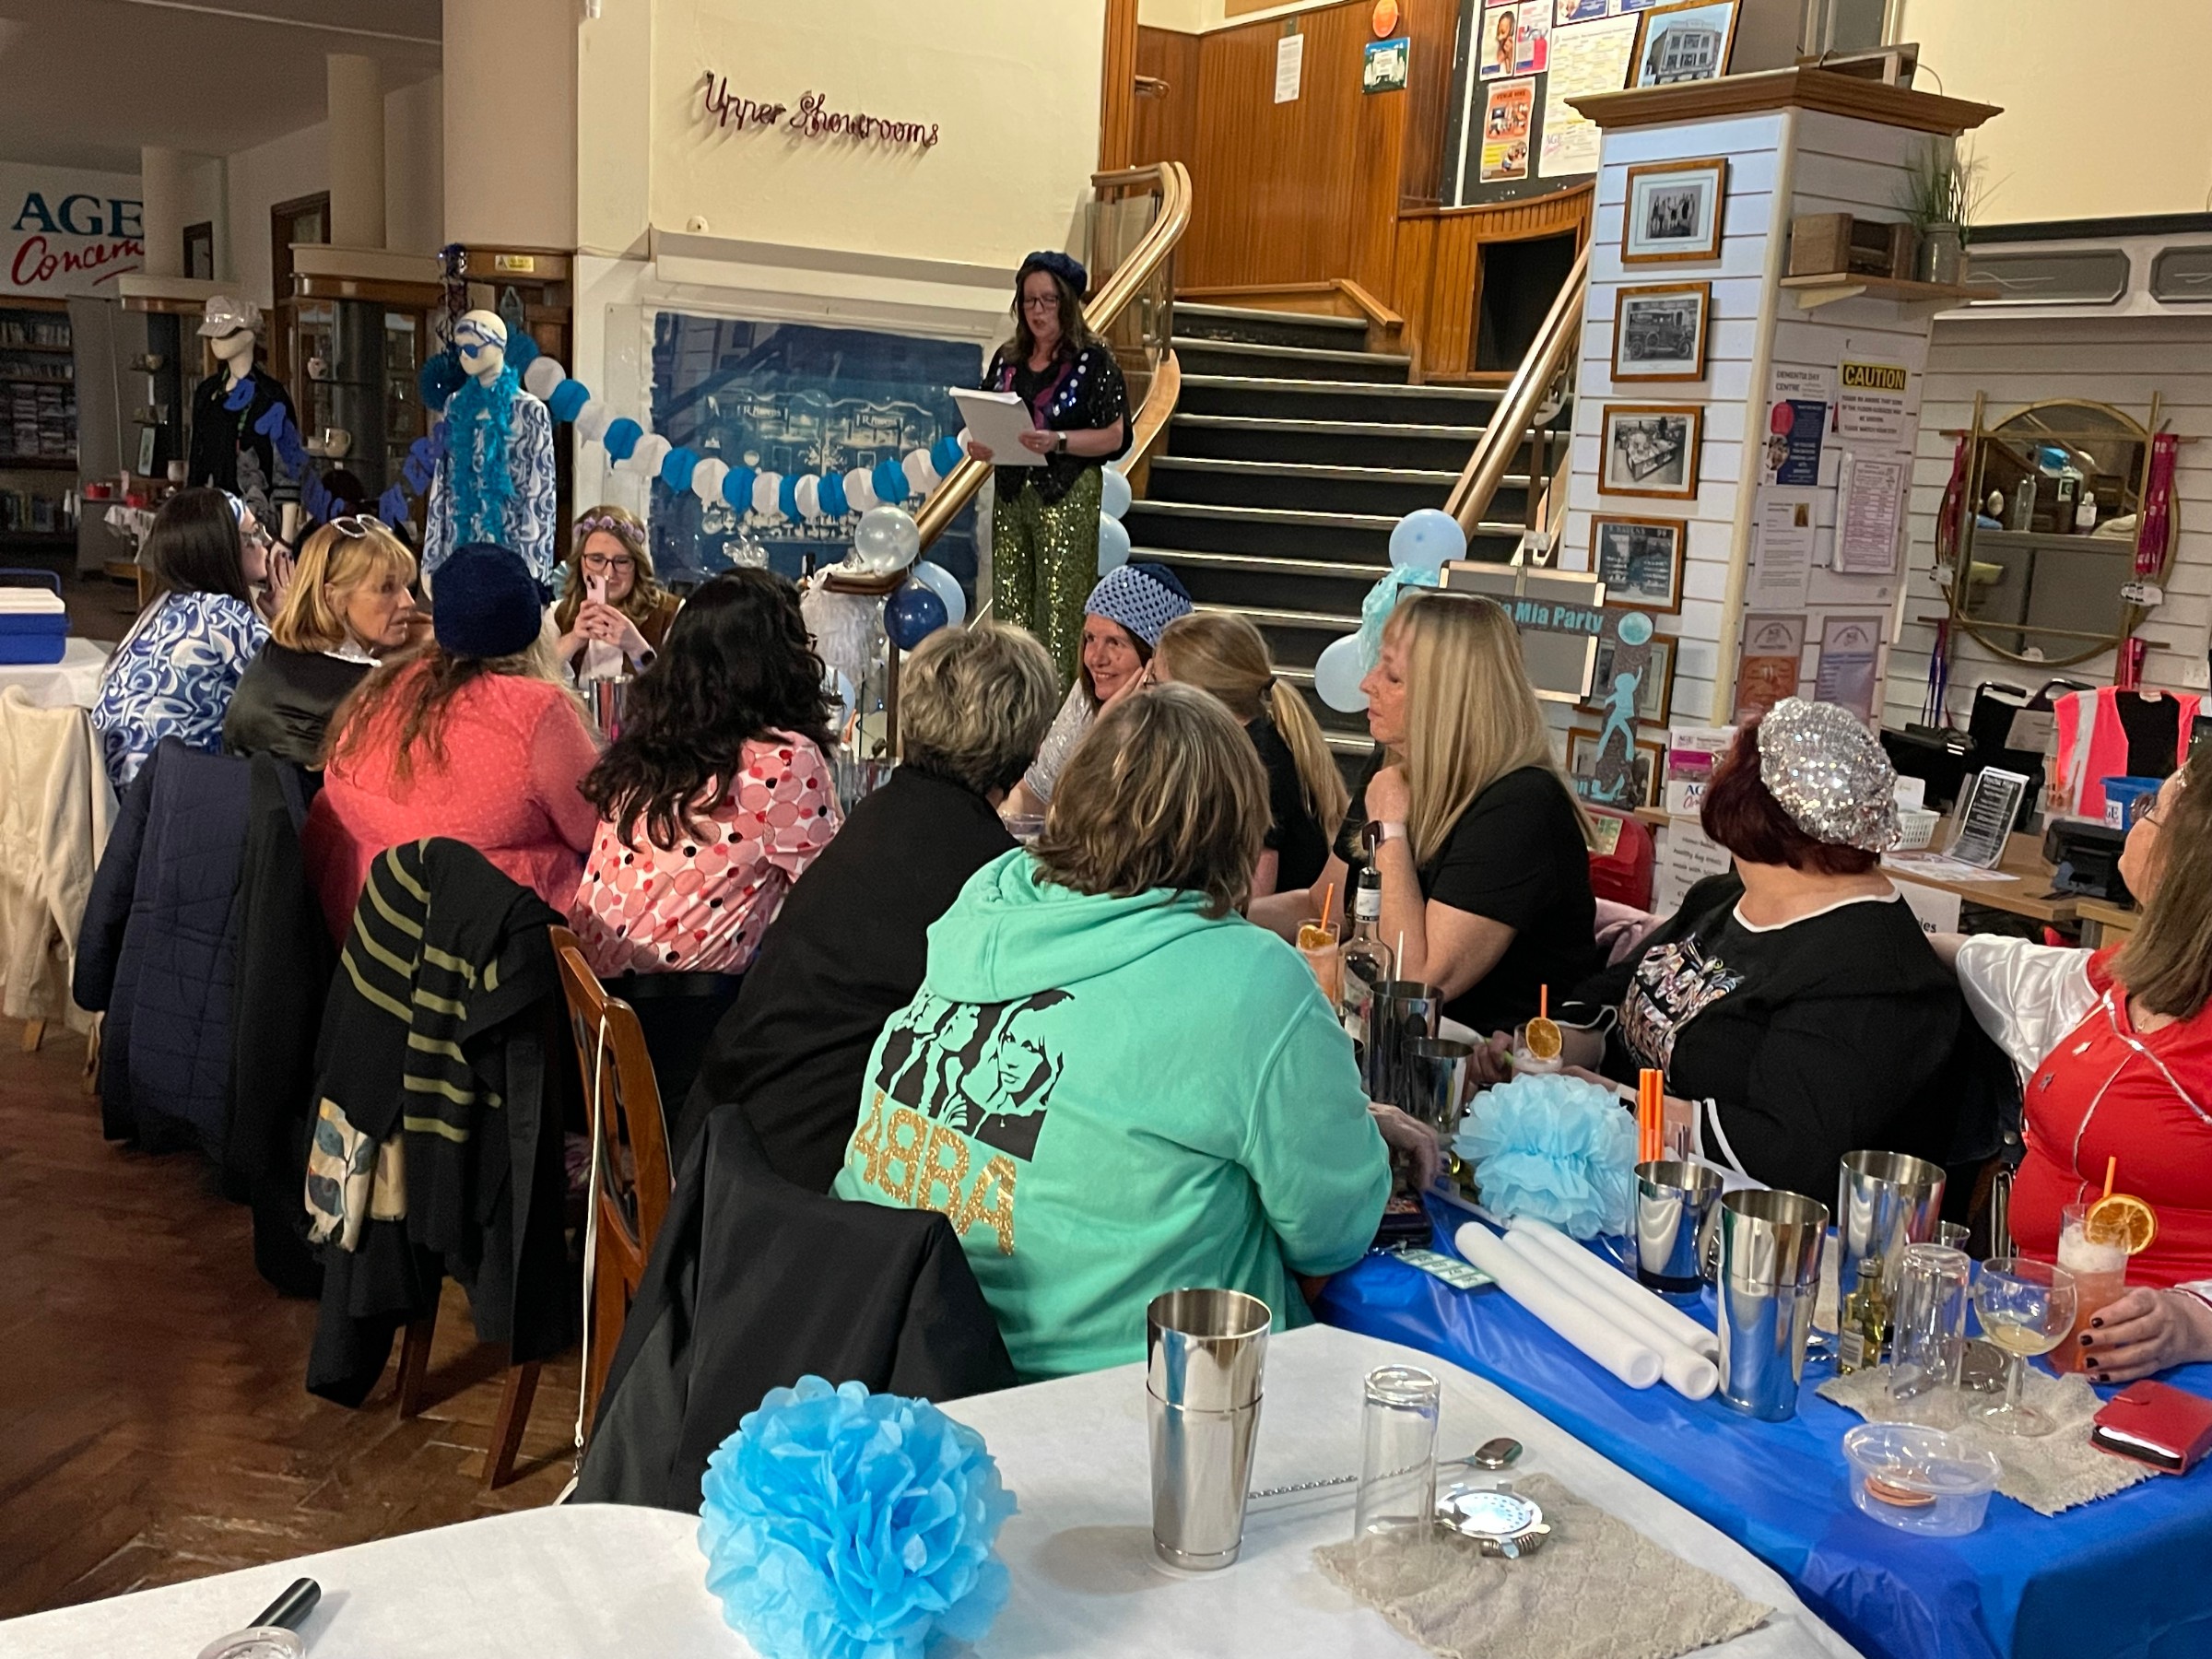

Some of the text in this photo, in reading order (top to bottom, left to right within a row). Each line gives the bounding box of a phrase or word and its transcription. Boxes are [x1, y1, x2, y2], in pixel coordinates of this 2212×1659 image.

[706, 72, 939, 147] Upper Showrooms
[11, 192, 144, 240] AGE
[11, 235, 145, 286] Concern
[1844, 365, 1905, 390] CAUTION
[1514, 602, 1549, 625] Mia
[1552, 606, 1604, 634] Party
[1685, 784, 1706, 797] AG
[848, 1091, 1017, 1256] ABBA
